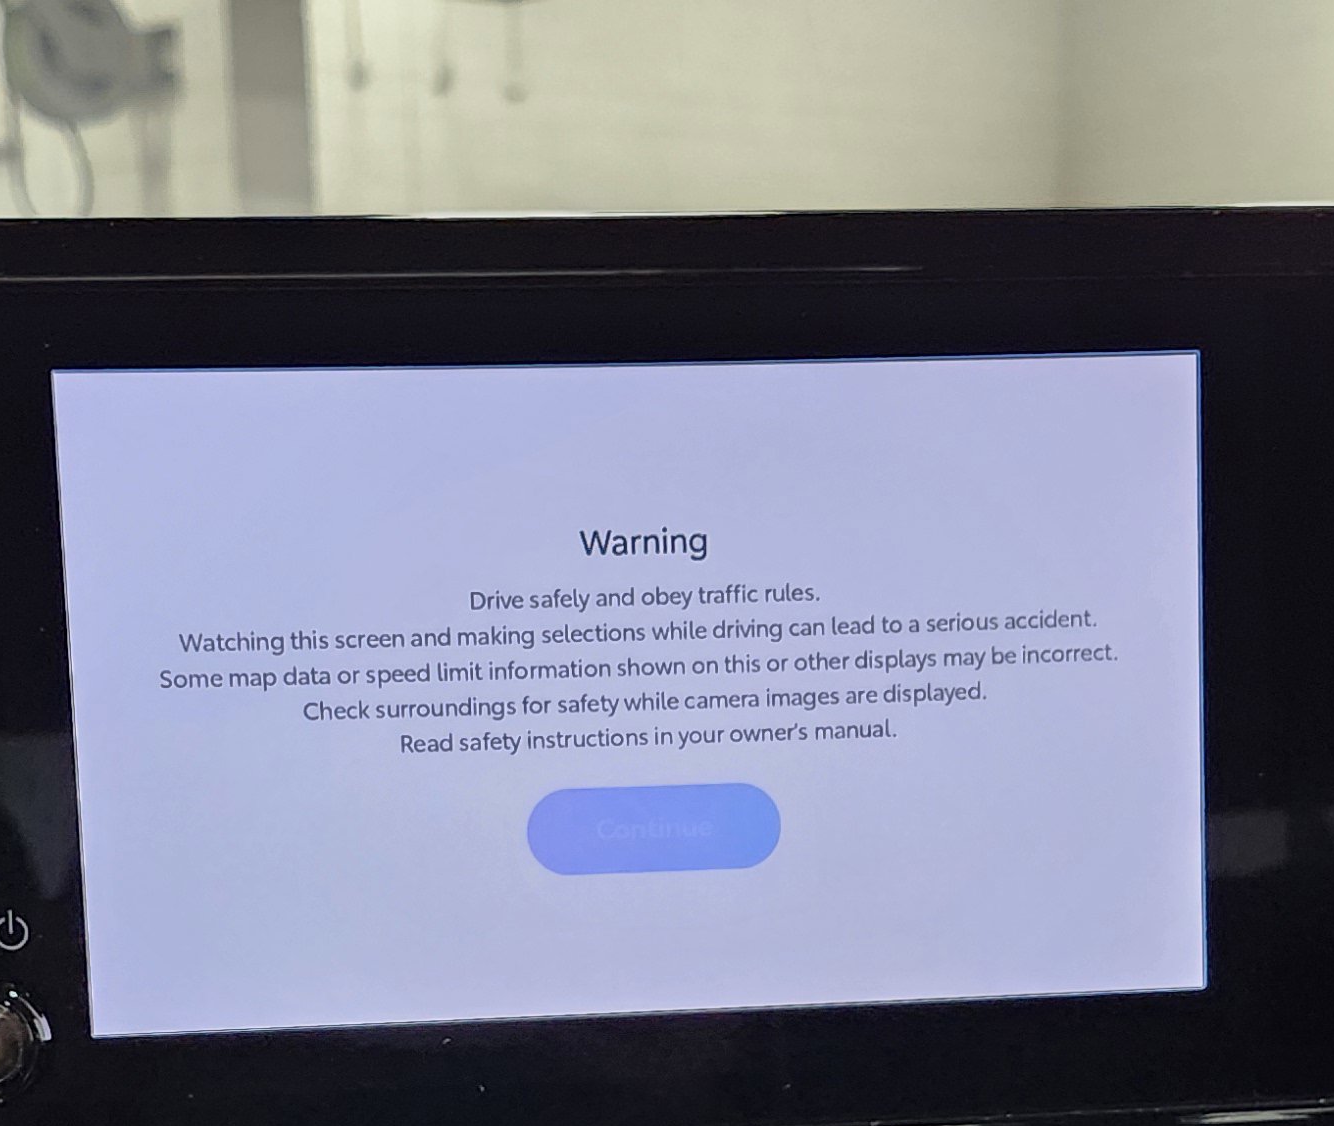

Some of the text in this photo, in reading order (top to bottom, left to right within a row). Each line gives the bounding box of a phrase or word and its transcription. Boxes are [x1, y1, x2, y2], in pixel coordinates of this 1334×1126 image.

[578, 525, 708, 562] Warning
[469, 582, 821, 614] Drive safely and obey traffic rules.
[178, 608, 1097, 657] Watching this screen and making selections while driving can lead to a serious accident.
[159, 643, 1119, 693] Some map data or speed limit information shown on this or other displays may be incorrect.
[302, 680, 988, 722] Check surroundings for safety while camera images are displayed.
[400, 717, 898, 756] Read safety instructions in your owner's manual.
[596, 816, 715, 841] Continue
